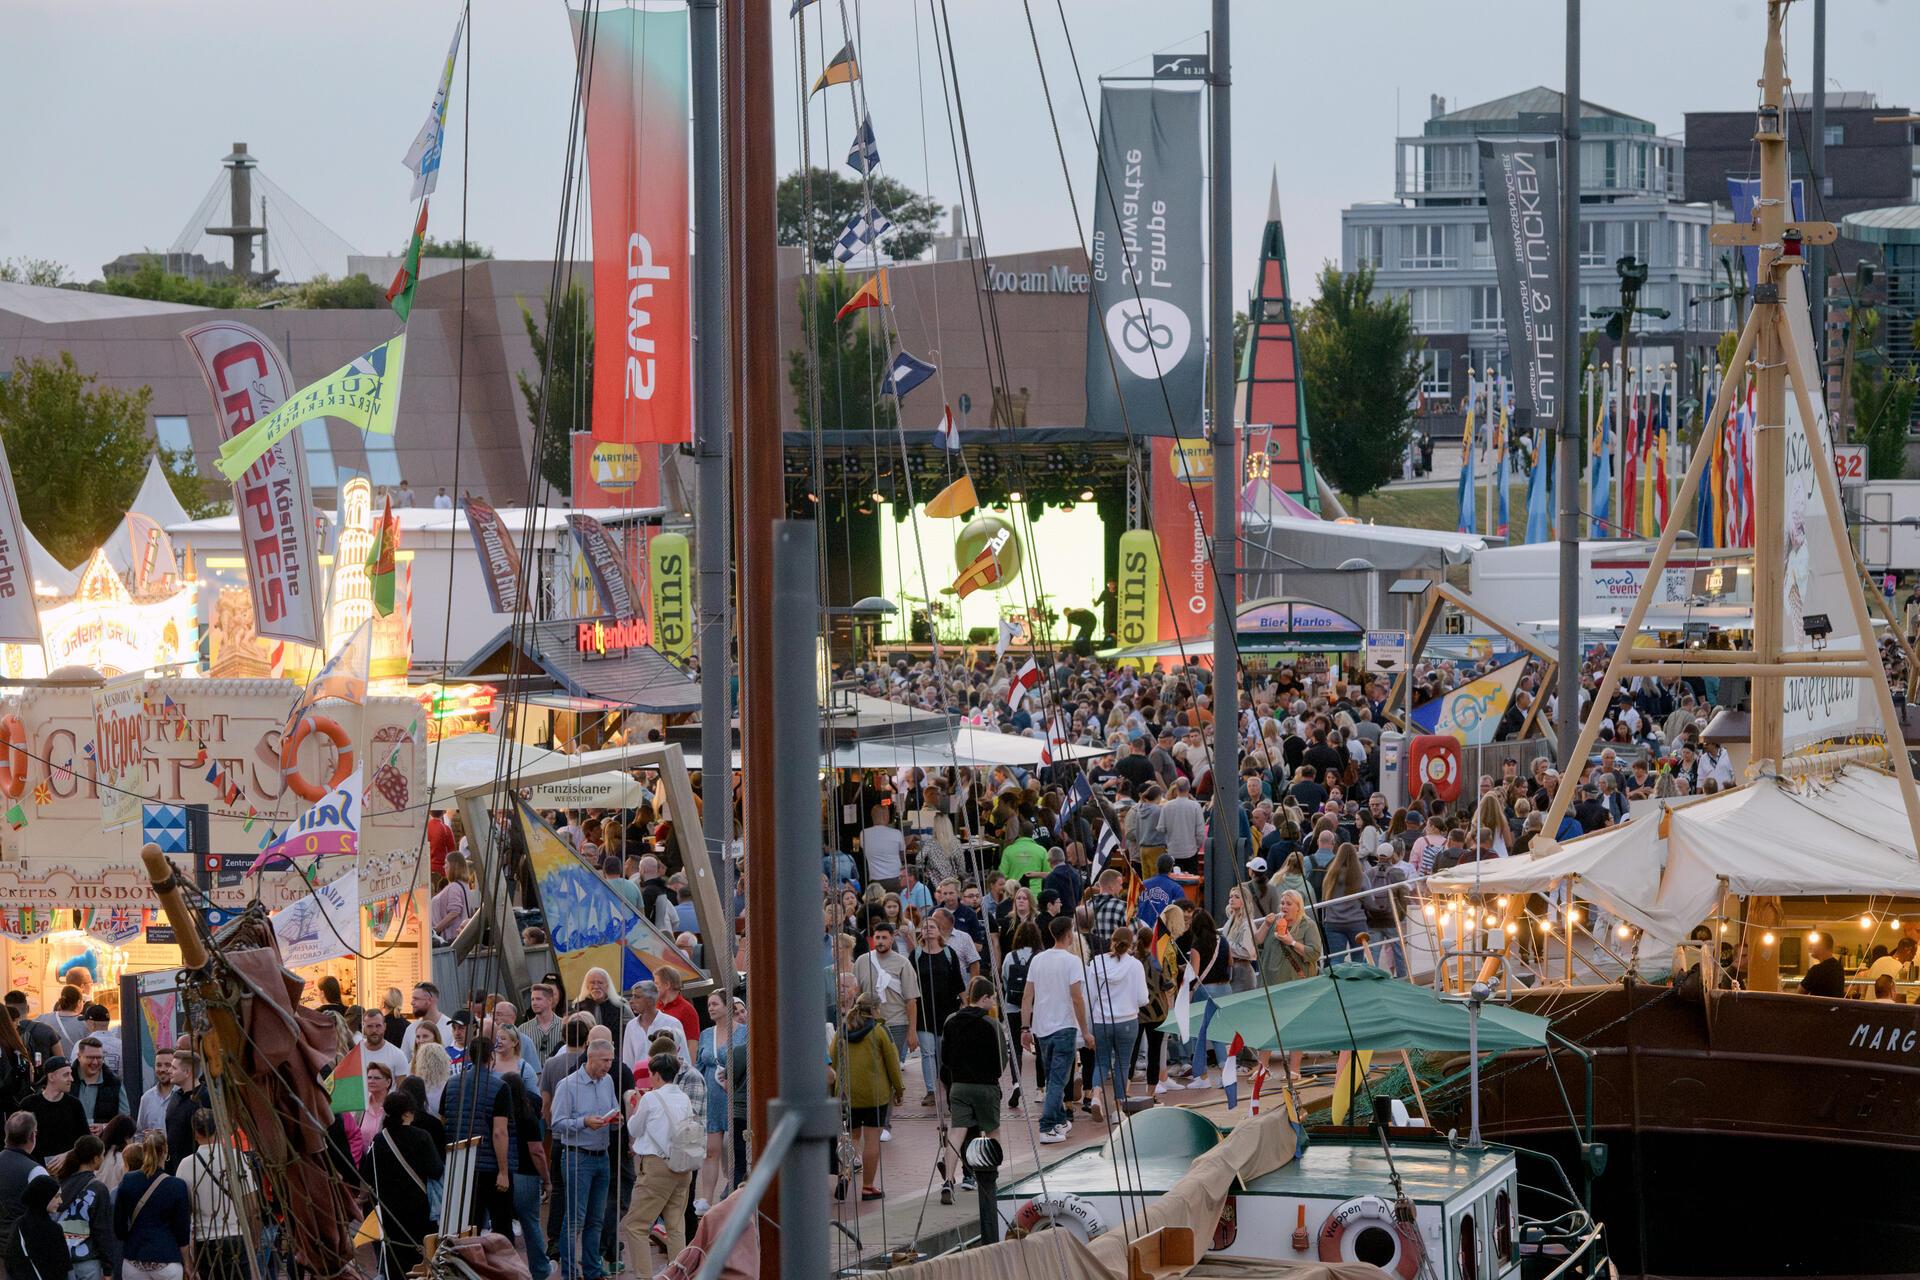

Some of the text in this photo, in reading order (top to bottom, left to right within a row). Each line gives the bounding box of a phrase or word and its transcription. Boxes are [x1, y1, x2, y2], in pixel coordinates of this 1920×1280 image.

[982, 263, 1090, 293] Zoo am Mee
[593, 453, 639, 462] MARITIME
[272, 478, 300, 597] Köstliche
[1595, 570, 1634, 588] nord
[1259, 617, 1332, 628] Bier- Harlos
[579, 618, 648, 655] Frittenbude
[95, 709, 143, 778] Crêpes
[536, 783, 612, 794] Franziskaner
[67, 886, 160, 899] AUSBOR
[2, 917, 49, 937] Kaee
[1070, 1203, 1087, 1219] von
[1325, 1203, 1362, 1239] Wappen
